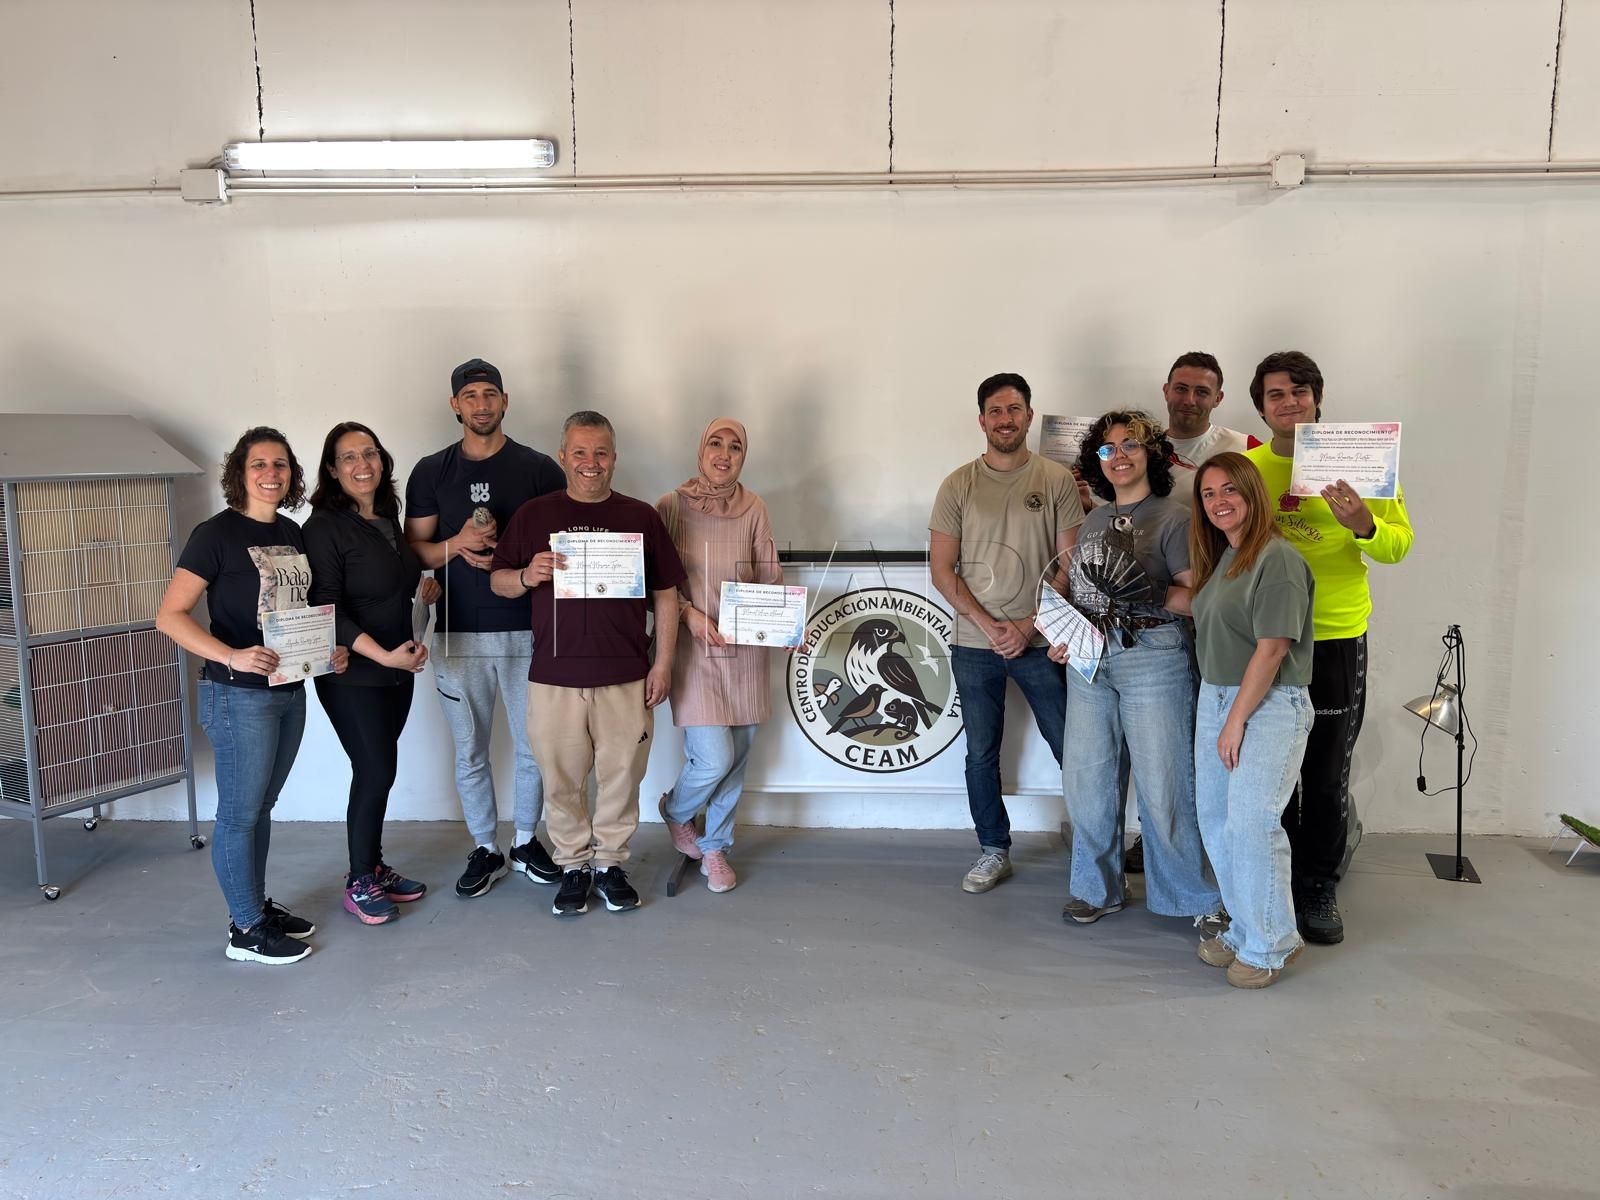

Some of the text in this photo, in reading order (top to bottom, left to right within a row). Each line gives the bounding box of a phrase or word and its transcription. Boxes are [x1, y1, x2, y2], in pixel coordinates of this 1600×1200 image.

[276, 565, 310, 587] Bala
[290, 586, 307, 603] nc
[804, 595, 879, 649] EDUCACIÓN
[880, 597, 952, 642] AMBIENTAL
[796, 668, 817, 723] CENTRO
[1315, 707, 1343, 716] adidas
[845, 744, 920, 767] CEAM
